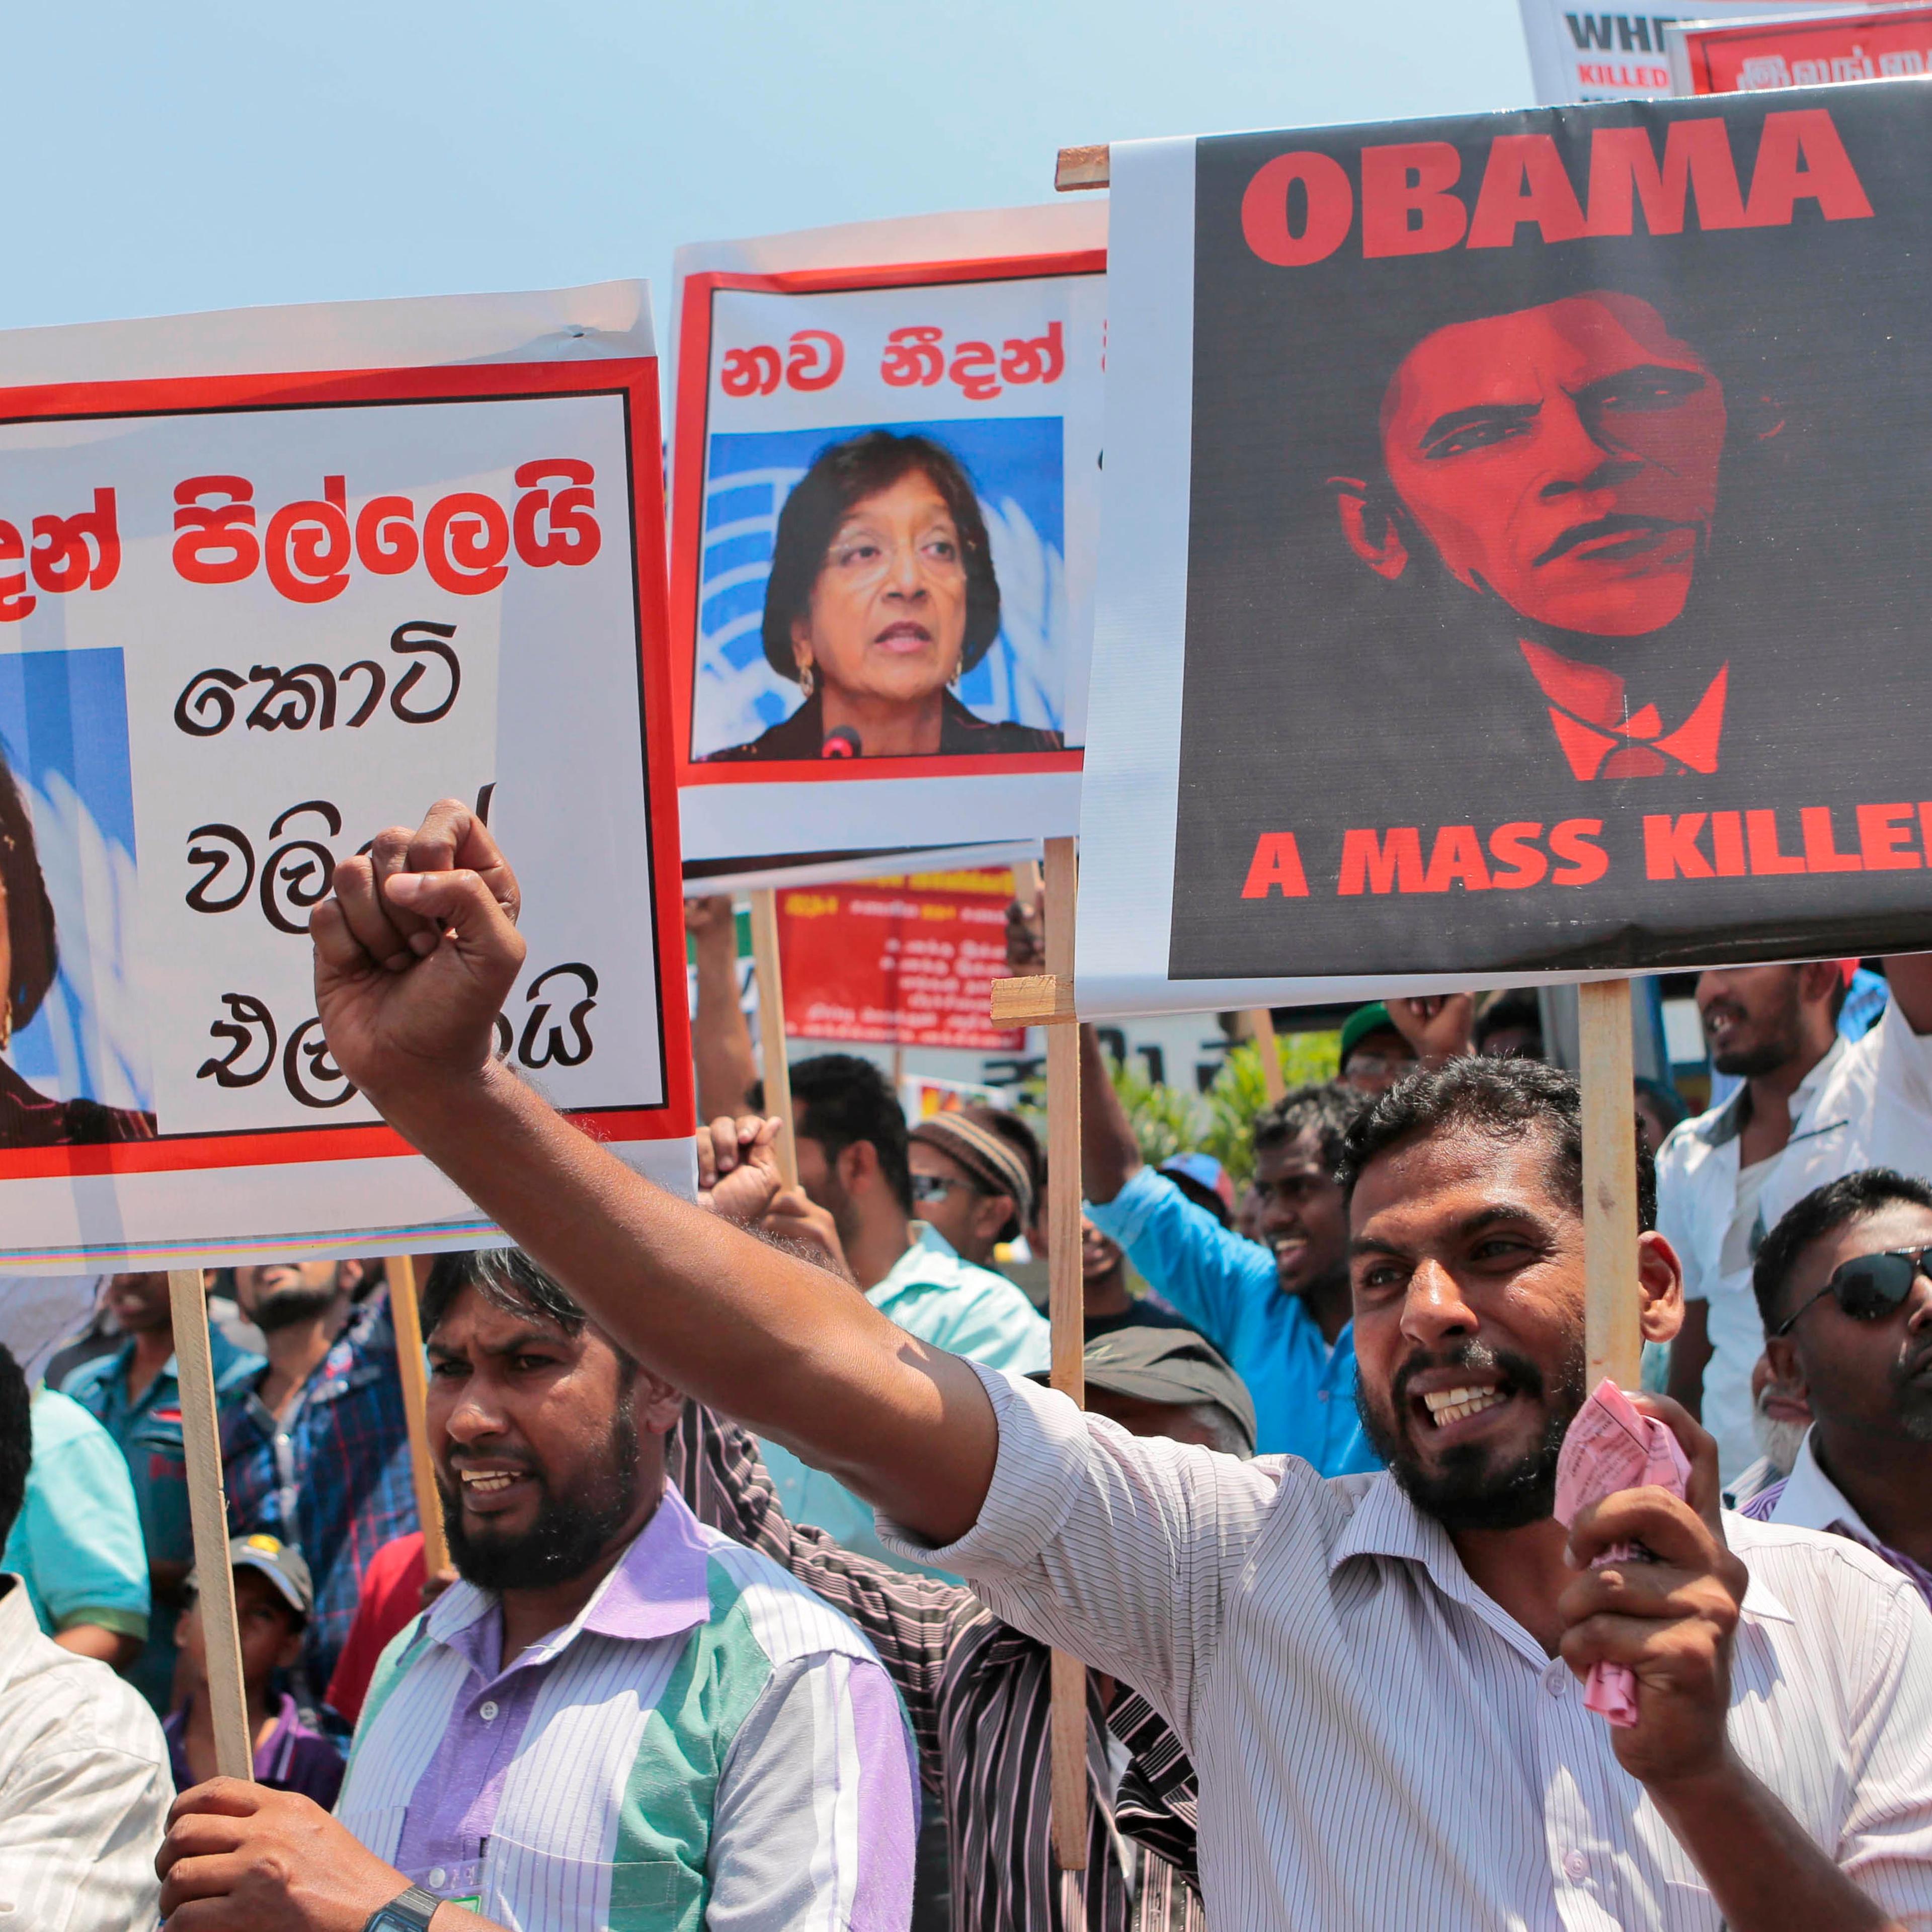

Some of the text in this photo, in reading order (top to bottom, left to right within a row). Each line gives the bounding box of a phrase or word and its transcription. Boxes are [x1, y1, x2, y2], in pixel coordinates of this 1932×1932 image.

[1578, 63, 1670, 89] KILLED
[1241, 109, 1875, 267] OBAMA
[720, 330, 845, 398] නව
[880, 321, 1066, 400] නීදන්
[172, 458, 602, 604] පිල්ලෙයි
[174, 620, 461, 737] කොටි
[1241, 800, 1932, 899] A MASS KILLE
